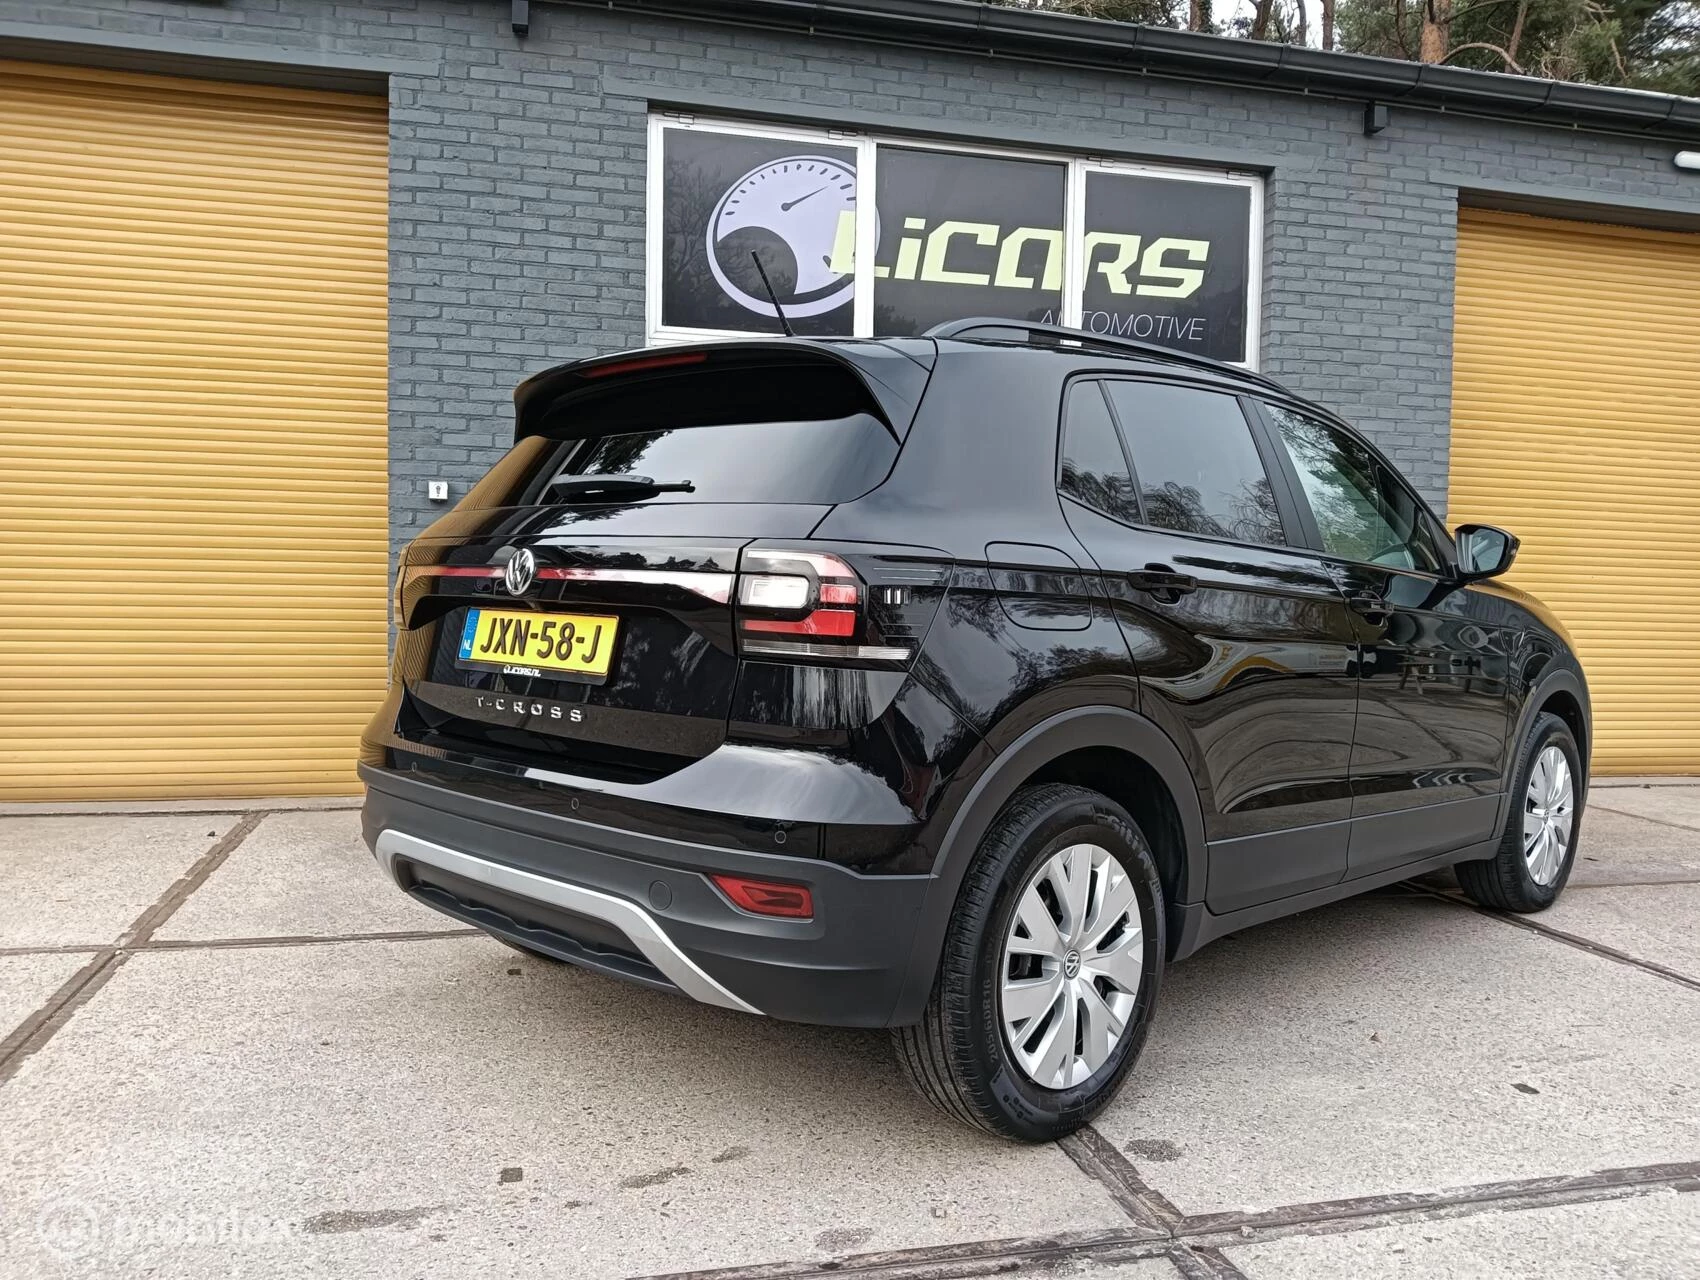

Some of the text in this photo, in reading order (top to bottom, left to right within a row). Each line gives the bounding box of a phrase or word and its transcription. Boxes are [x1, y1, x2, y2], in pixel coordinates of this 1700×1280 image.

[1041, 309, 1207, 341] ATOMOTIVE
[462, 640, 472, 650] NL
[480, 617, 602, 663] JXN-58-J
[475, 696, 582, 722] T-CROSS
